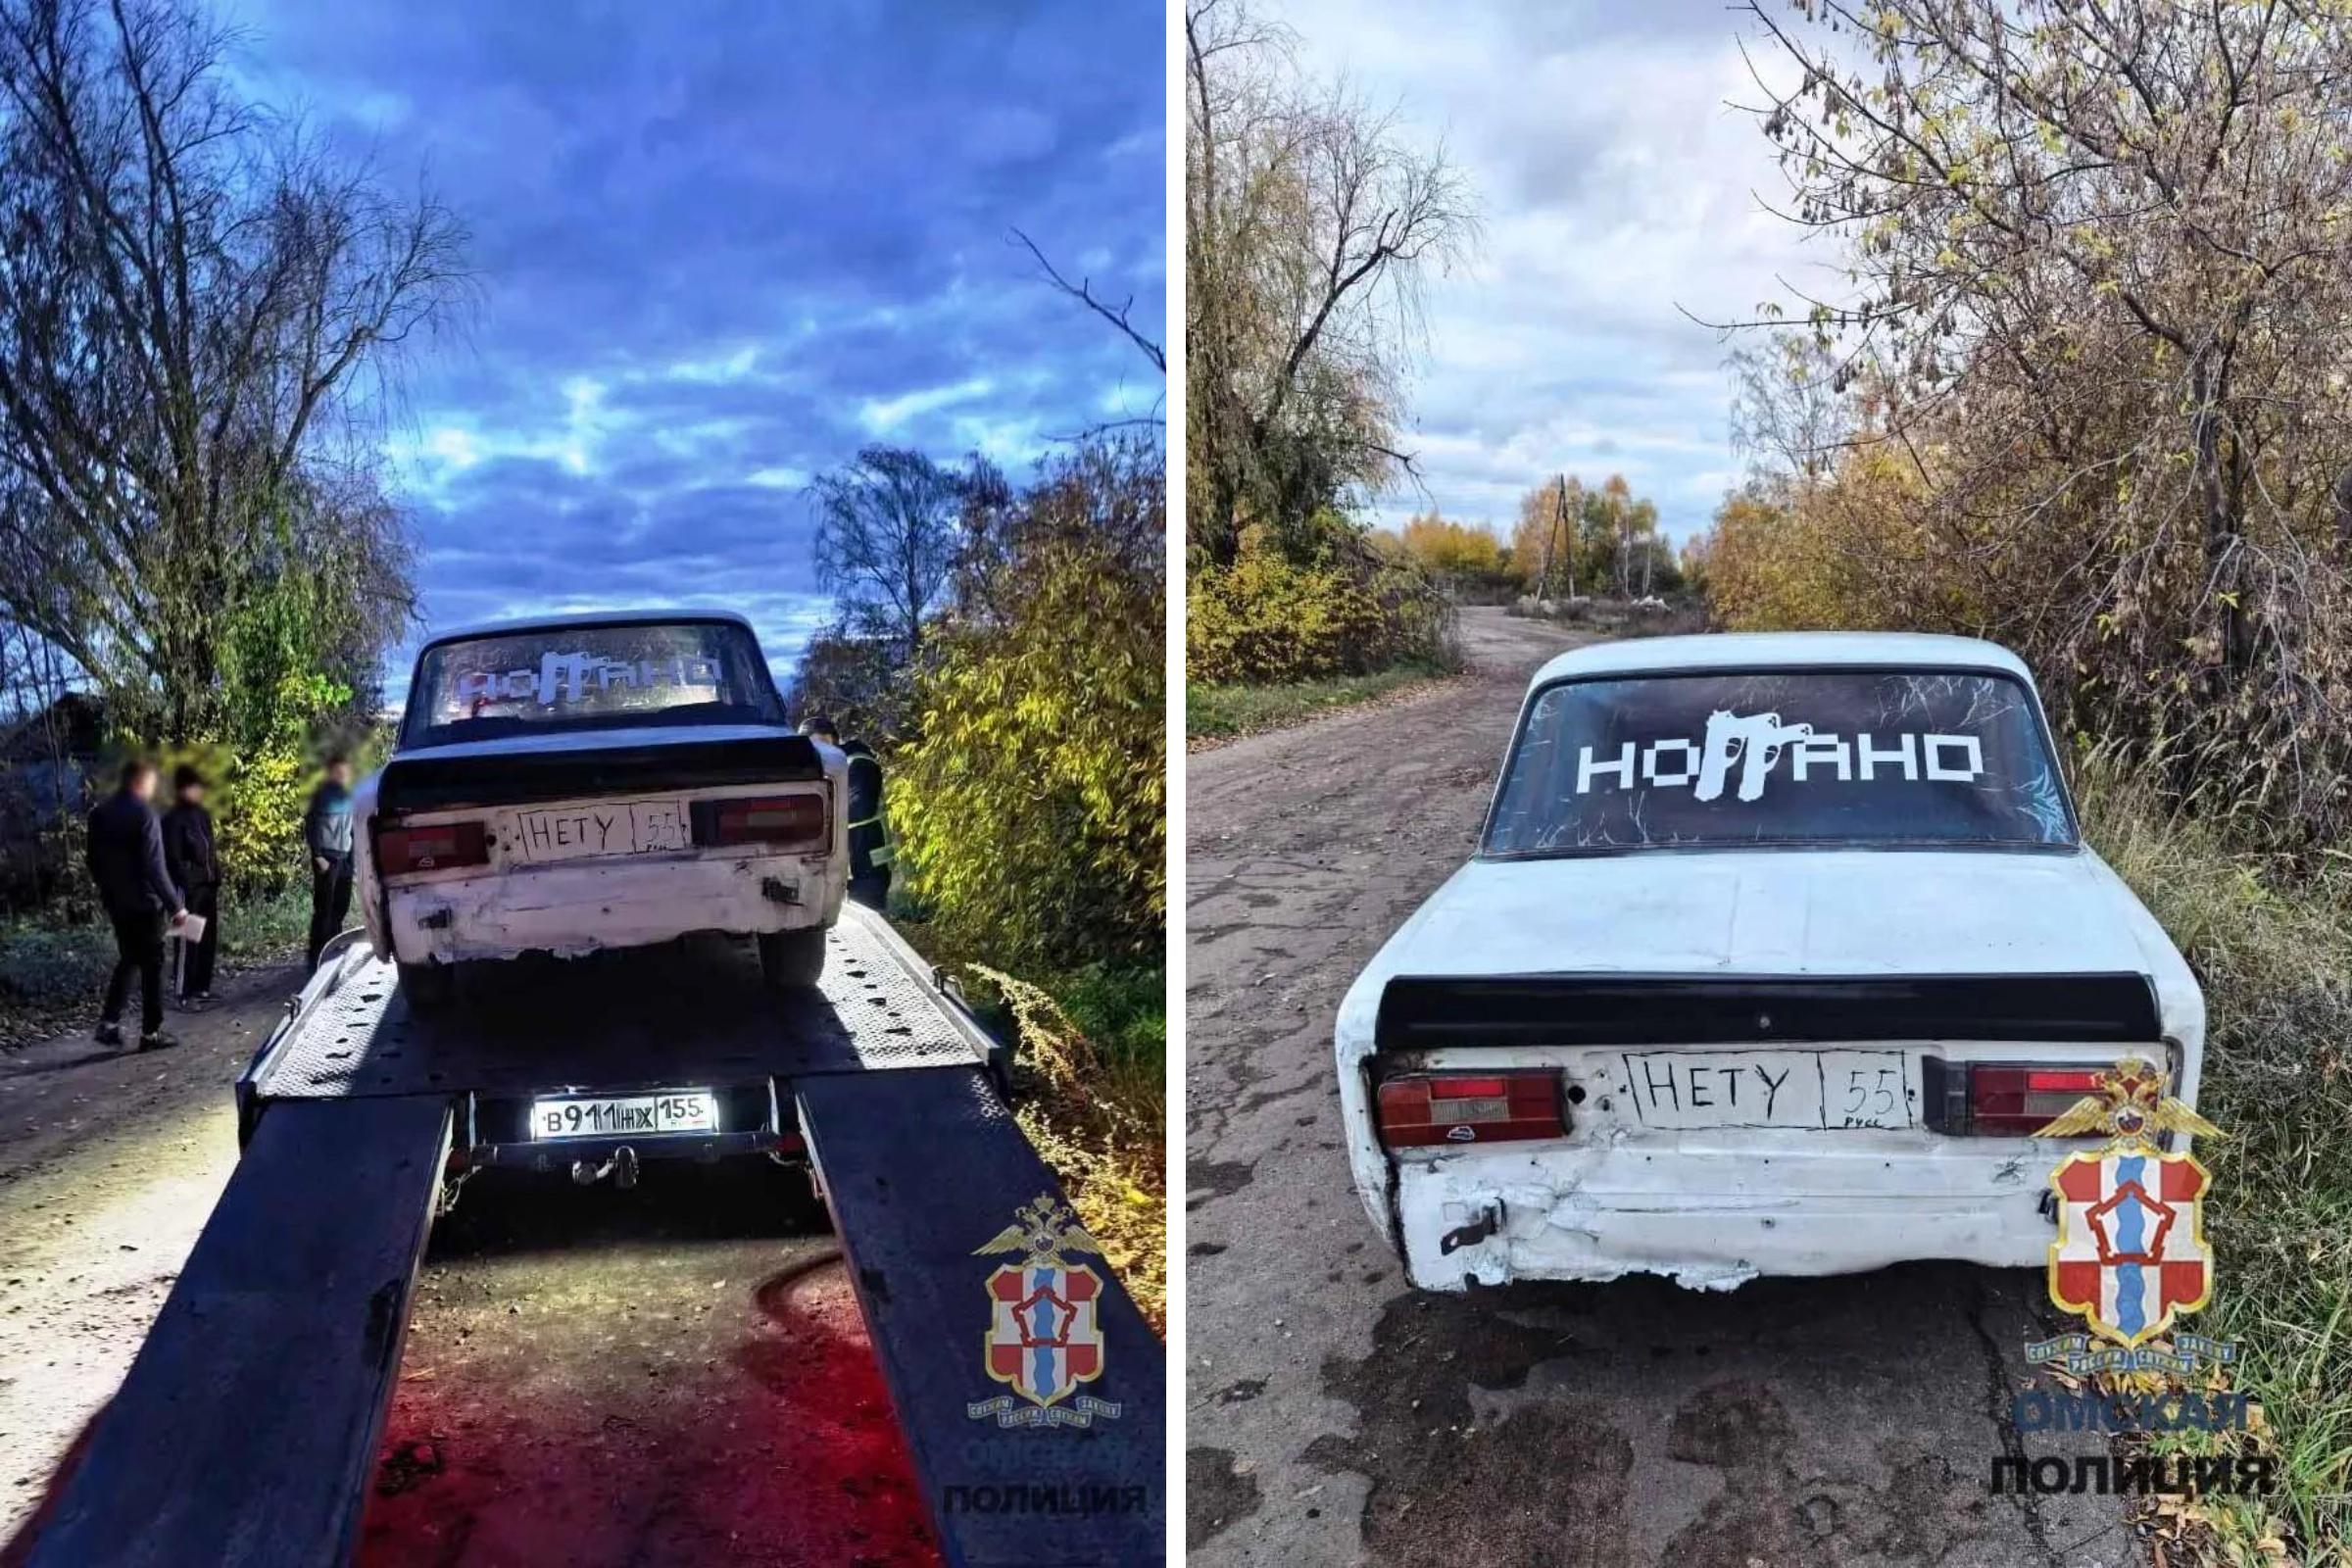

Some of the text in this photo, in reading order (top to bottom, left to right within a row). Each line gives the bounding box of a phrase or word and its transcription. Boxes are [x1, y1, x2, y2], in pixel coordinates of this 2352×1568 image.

[528, 812, 677, 849] НЕТУ 55
[660, 1098, 701, 1119] 155
[1644, 1061, 1896, 1120] НЕТУ 55
